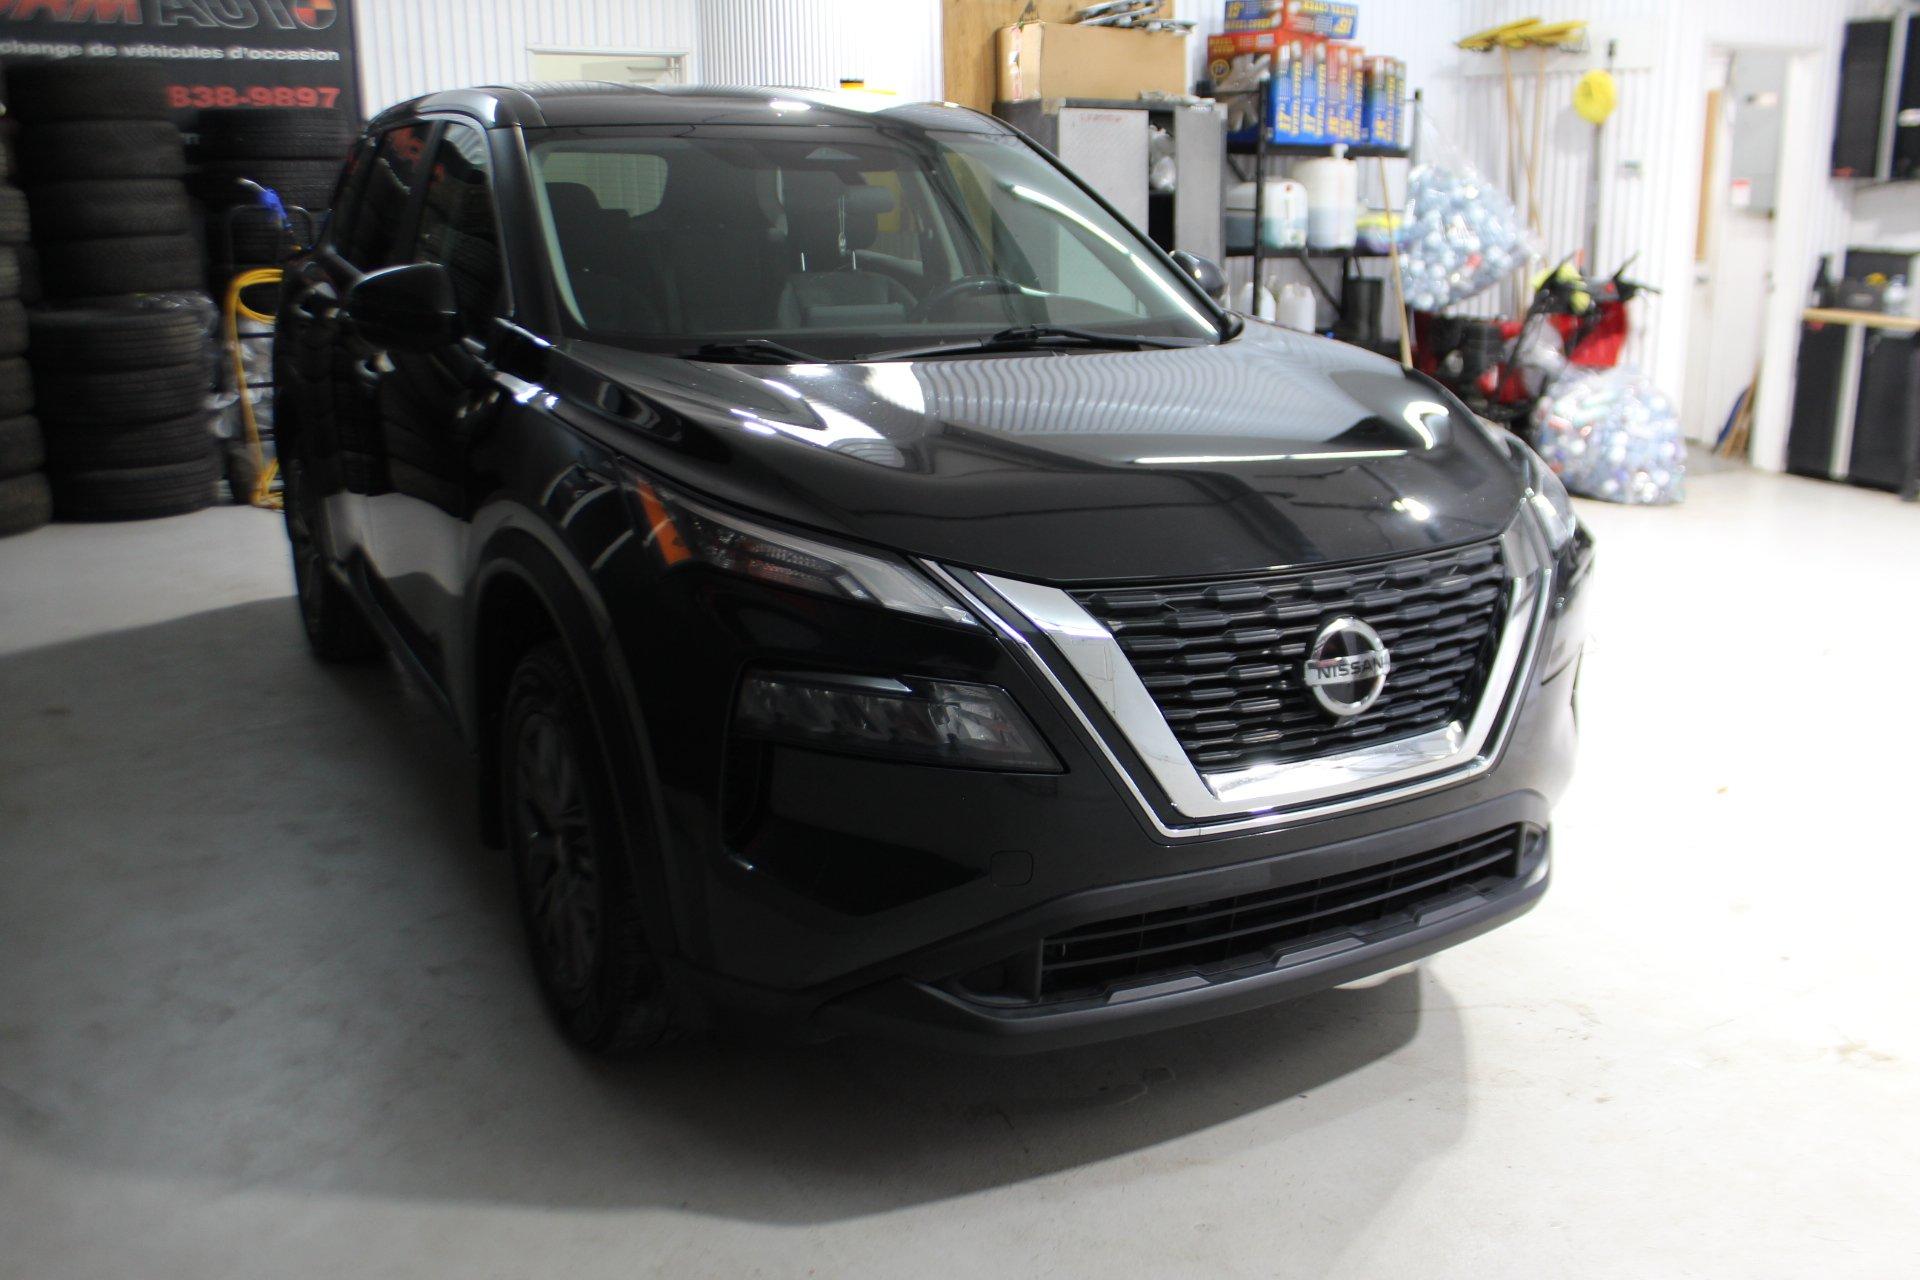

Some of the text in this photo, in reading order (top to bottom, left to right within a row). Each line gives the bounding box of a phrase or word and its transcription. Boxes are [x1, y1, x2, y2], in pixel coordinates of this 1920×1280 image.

[90, 43, 118, 57] de
[123, 44, 224, 59] véhicules
[230, 47, 340, 61] d'occasion
[168, 85, 341, 109] 838-9897
[1317, 657, 1384, 679] NISSAN
